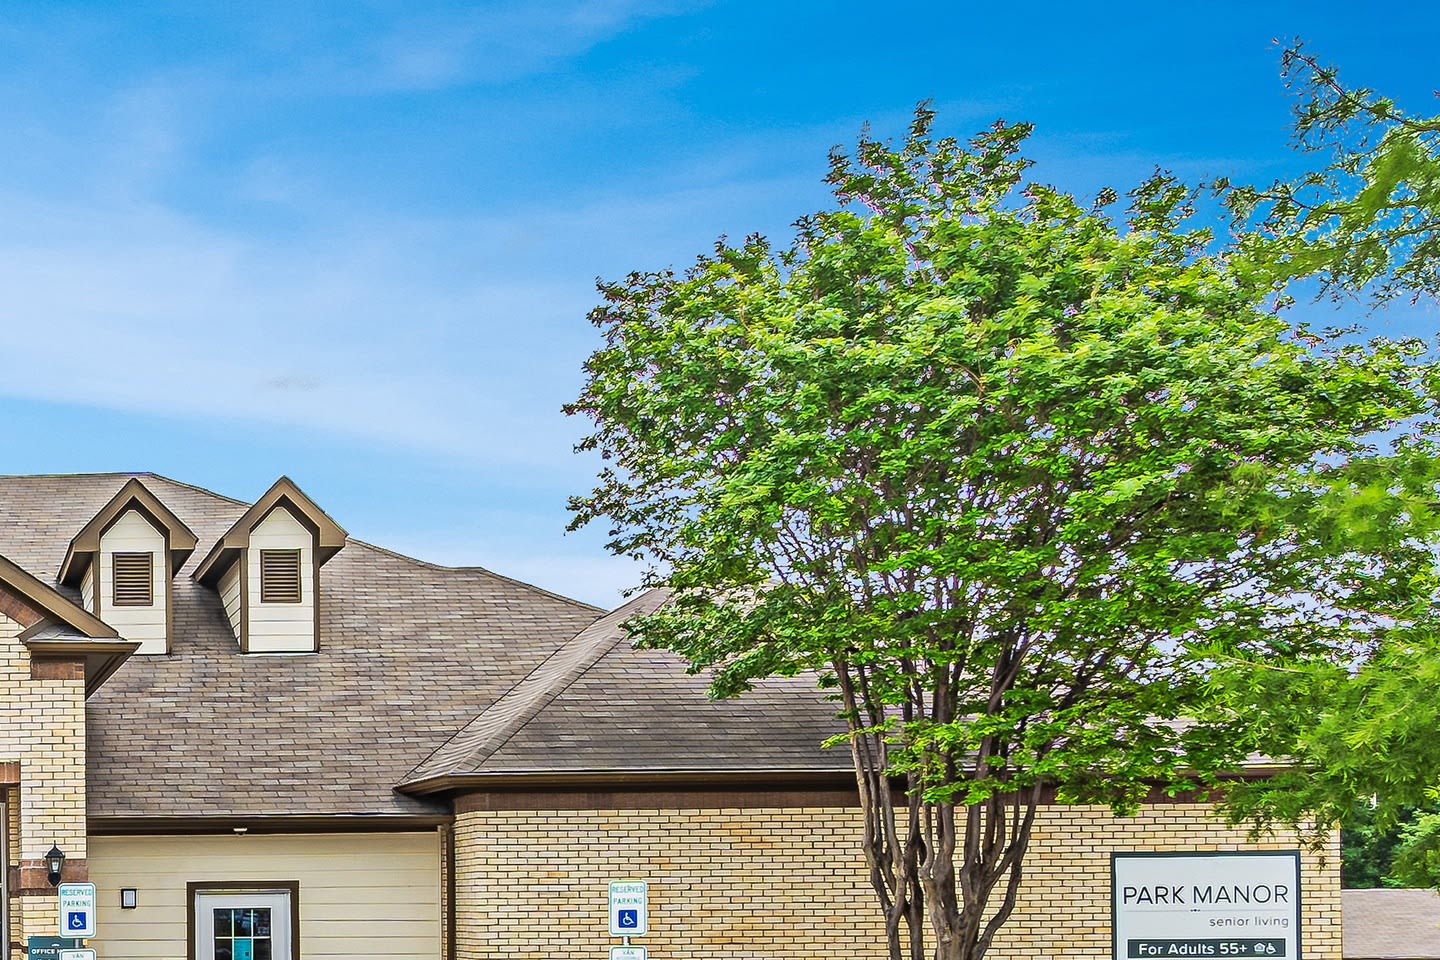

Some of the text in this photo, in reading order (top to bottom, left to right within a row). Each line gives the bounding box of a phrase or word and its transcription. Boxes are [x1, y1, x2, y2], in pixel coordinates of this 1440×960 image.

[61, 888, 93, 896] RESERVED
[612, 885, 644, 893] RESERVED
[1123, 884, 1289, 905] PARK MANOR
[613, 897, 643, 905] PARKING
[1209, 916, 1289, 928] senior living
[1138, 942, 1248, 955] For Adults 55+
